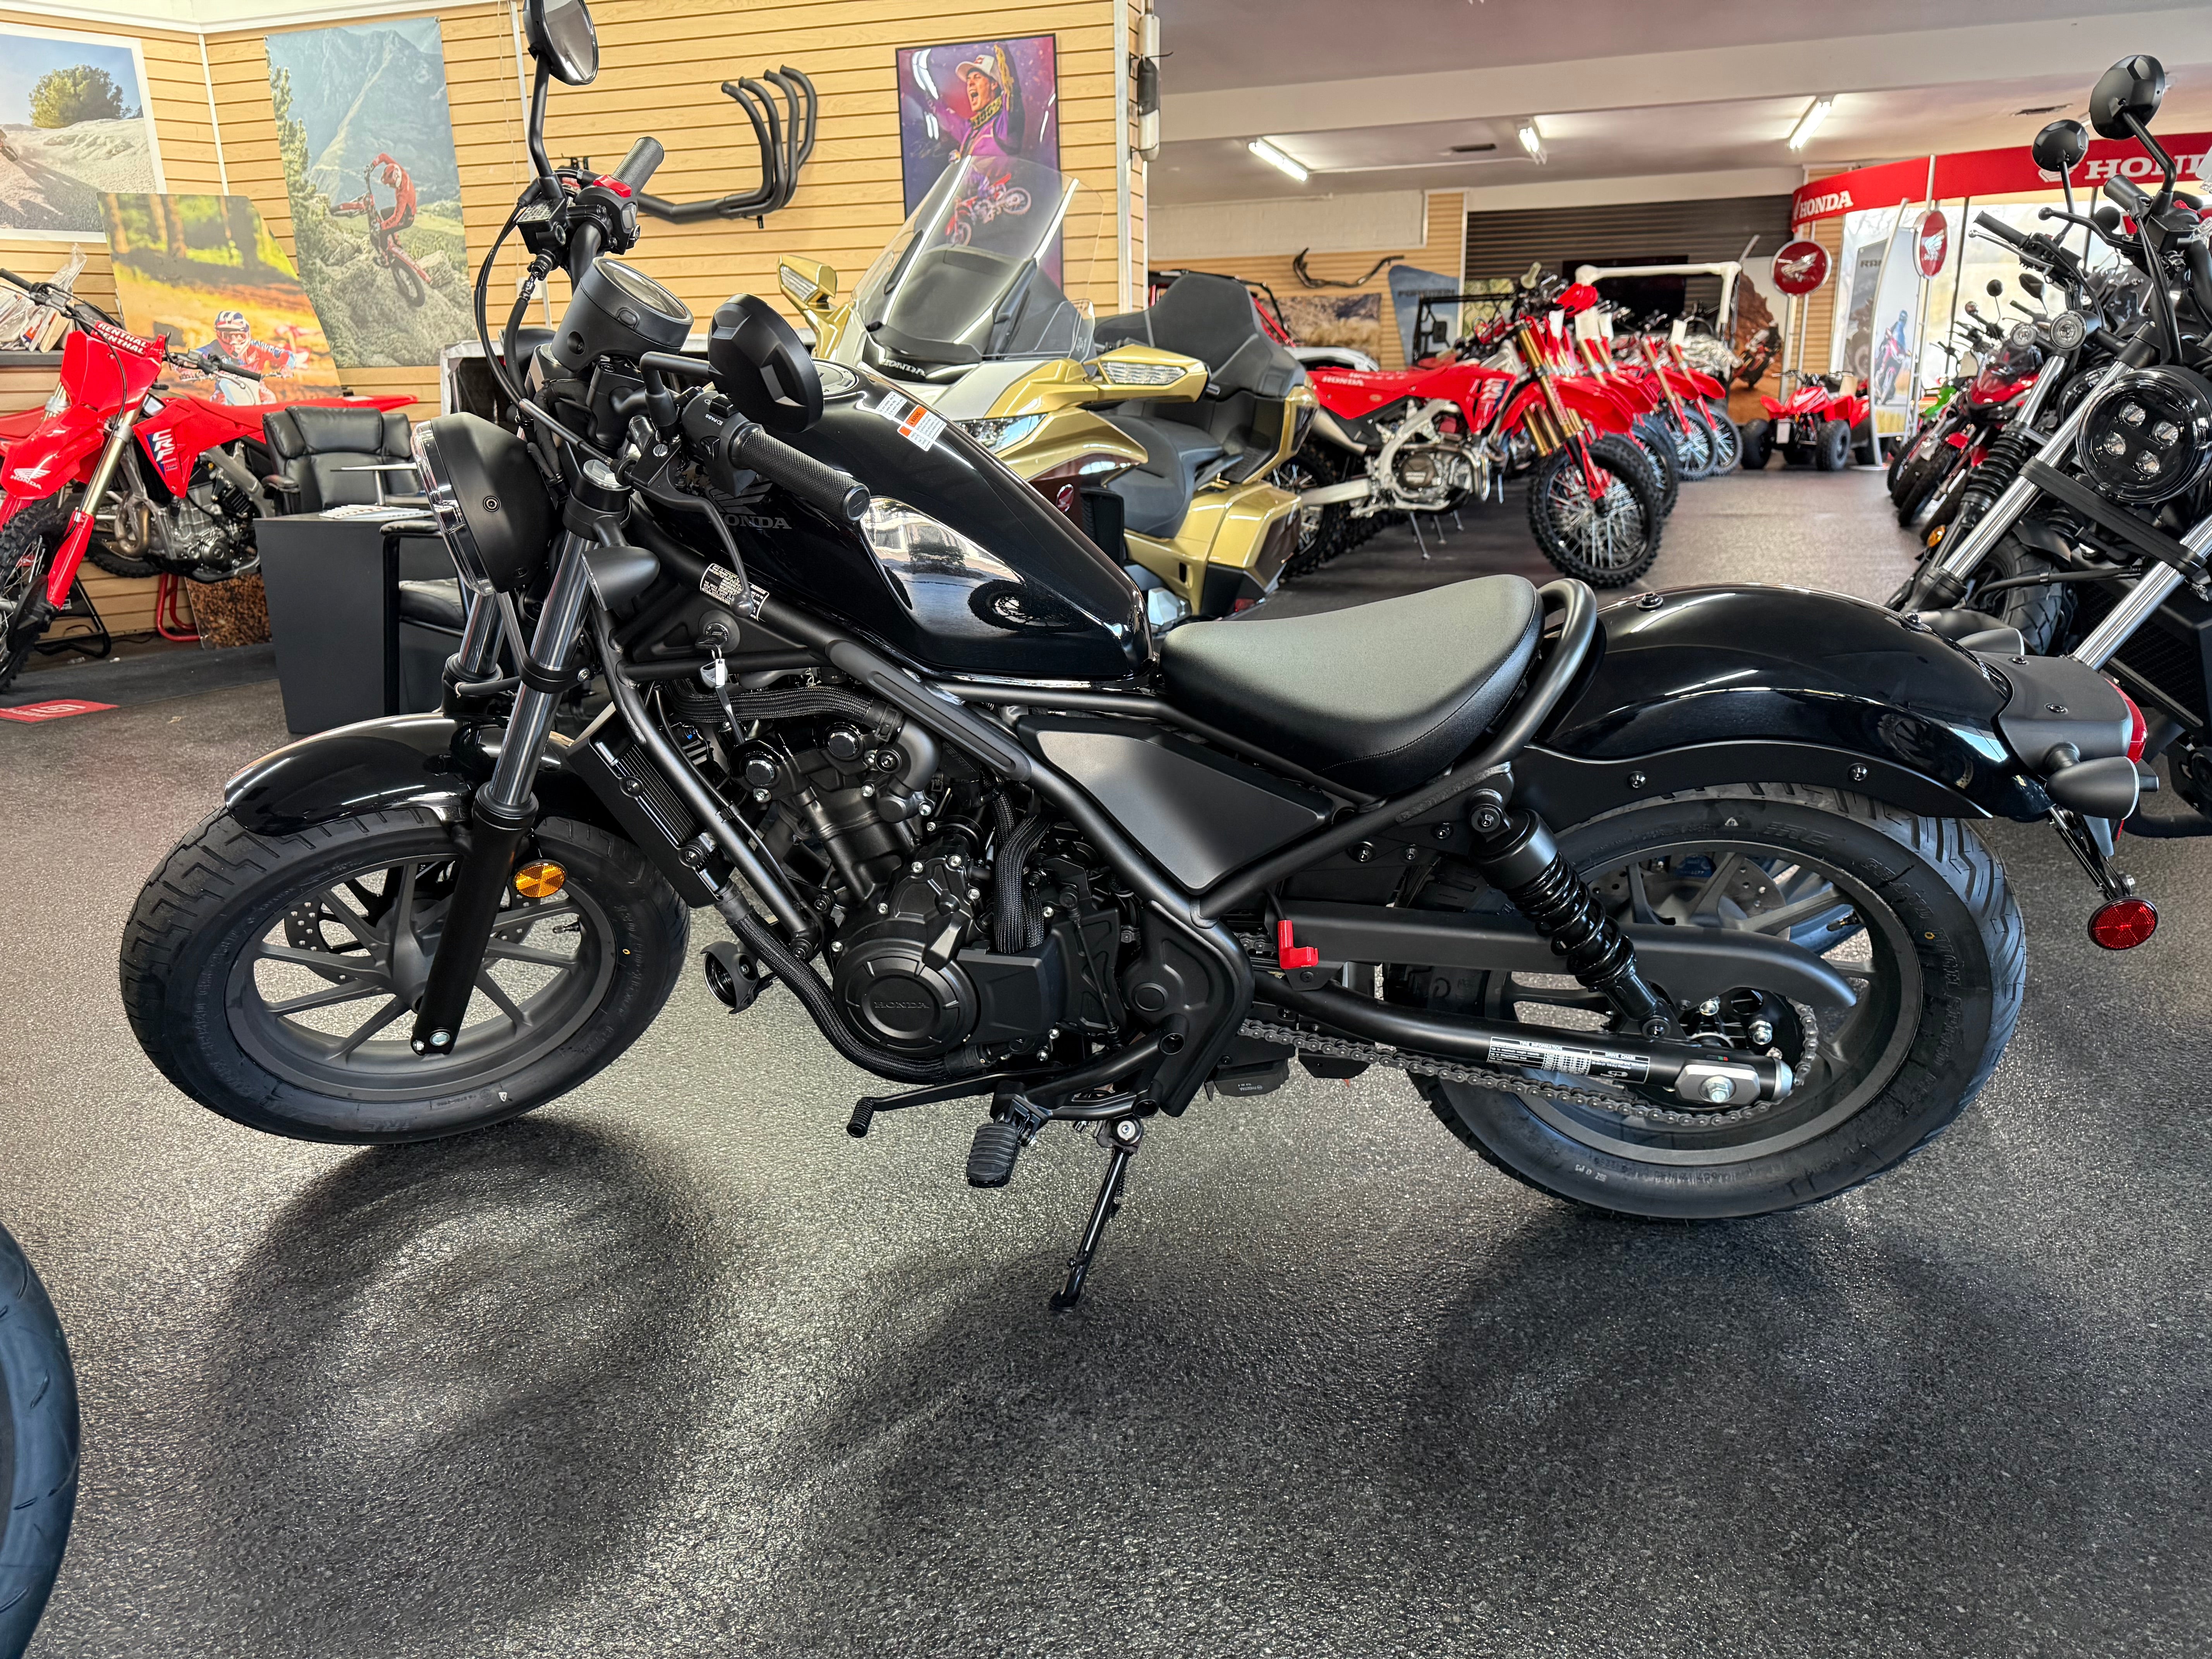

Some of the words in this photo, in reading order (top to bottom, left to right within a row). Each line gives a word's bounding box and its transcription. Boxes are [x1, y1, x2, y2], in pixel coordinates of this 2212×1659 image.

[1799, 190, 1853, 219] HONDA
[705, 414, 718, 423] PASS
[10, 475, 42, 490] HONDA
[719, 514, 792, 529] ONDA
[1531, 1042, 1563, 1051] INFORMATION
